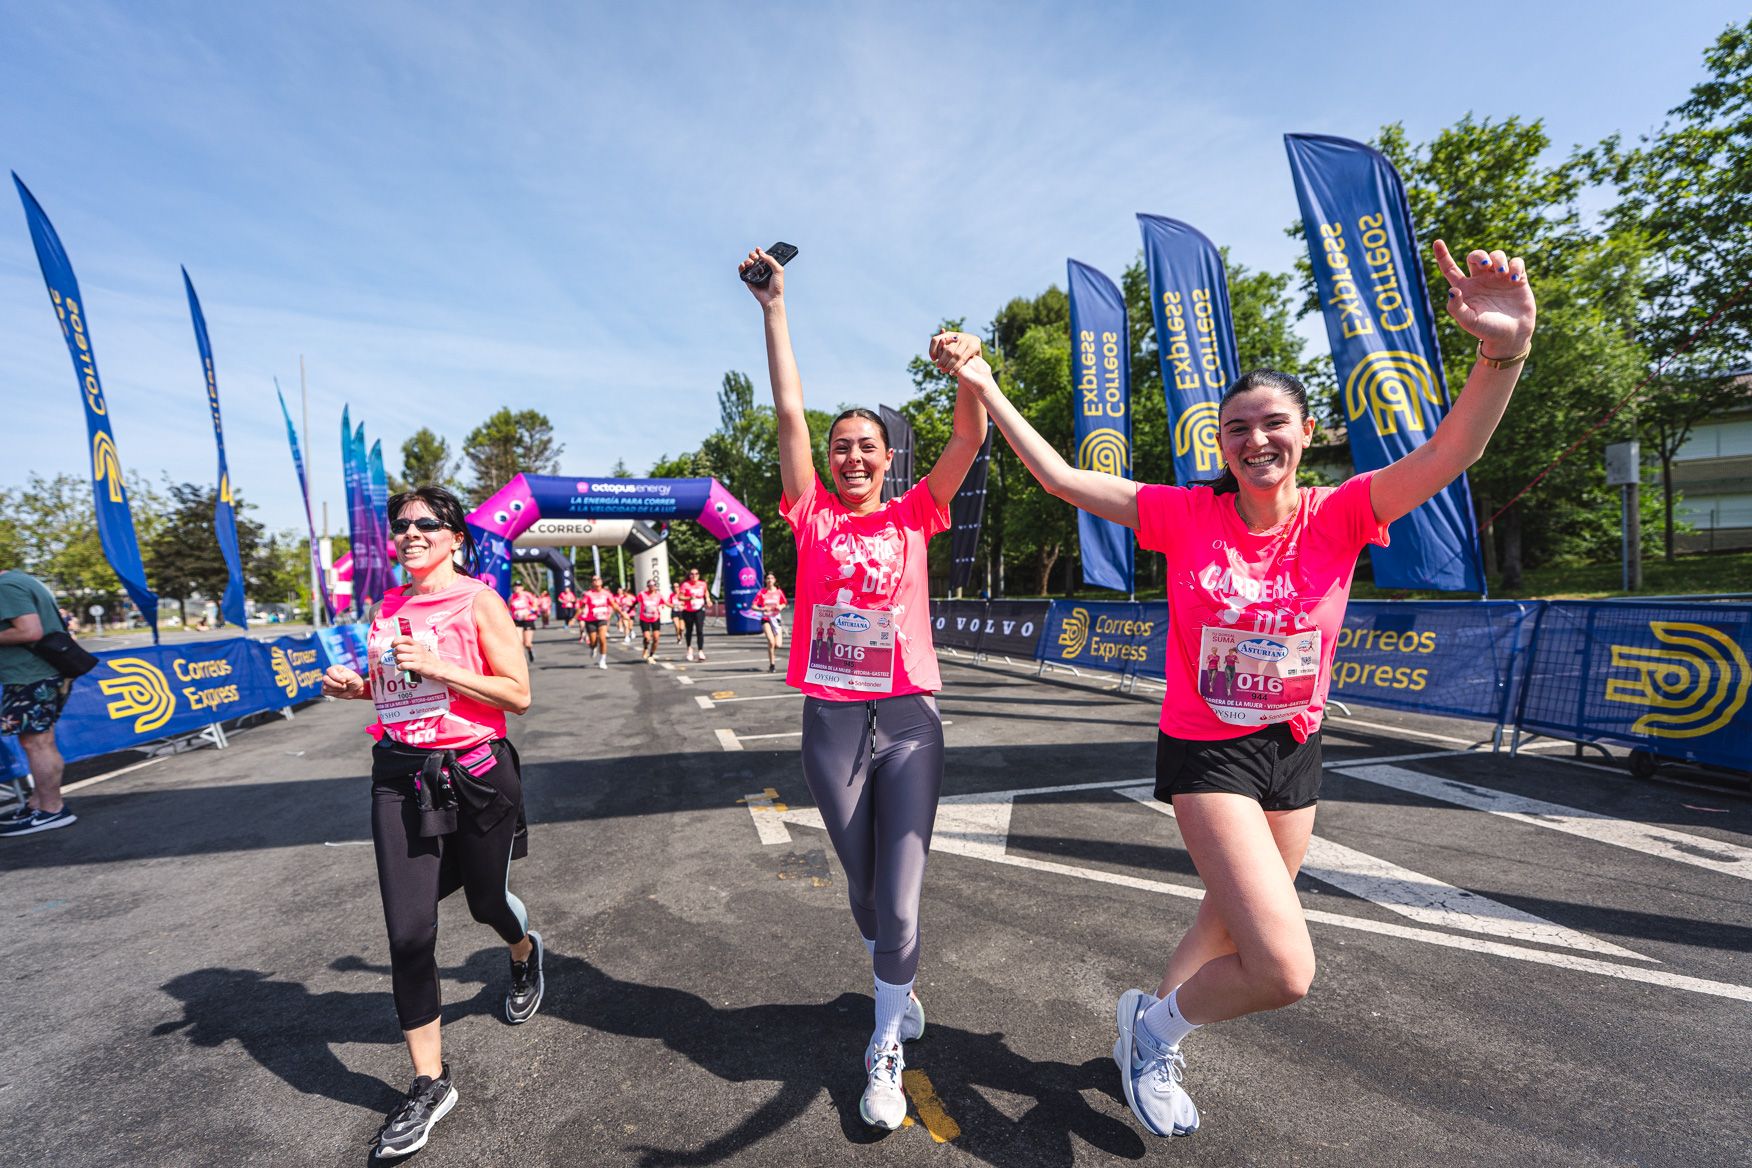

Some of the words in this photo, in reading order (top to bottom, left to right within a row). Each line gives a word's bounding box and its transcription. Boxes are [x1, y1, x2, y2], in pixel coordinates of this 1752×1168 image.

[538, 524, 592, 533] CORREO
[862, 567, 892, 595] DE
[957, 617, 1034, 637] VOLVO
[1095, 615, 1154, 636] Correos
[1253, 608, 1288, 636] DE
[1090, 637, 1148, 662] Express
[1212, 636, 1235, 644] SUMA
[1337, 627, 1436, 653] orreos
[834, 644, 865, 661] 016
[173, 658, 232, 682] Correos
[815, 673, 840, 682] OYSHO
[1331, 661, 1428, 690] xpress
[1237, 673, 1283, 692] 016
[182, 684, 240, 712] Express
[1243, 701, 1263, 709] MUJER
[1251, 693, 1268, 701] 944
